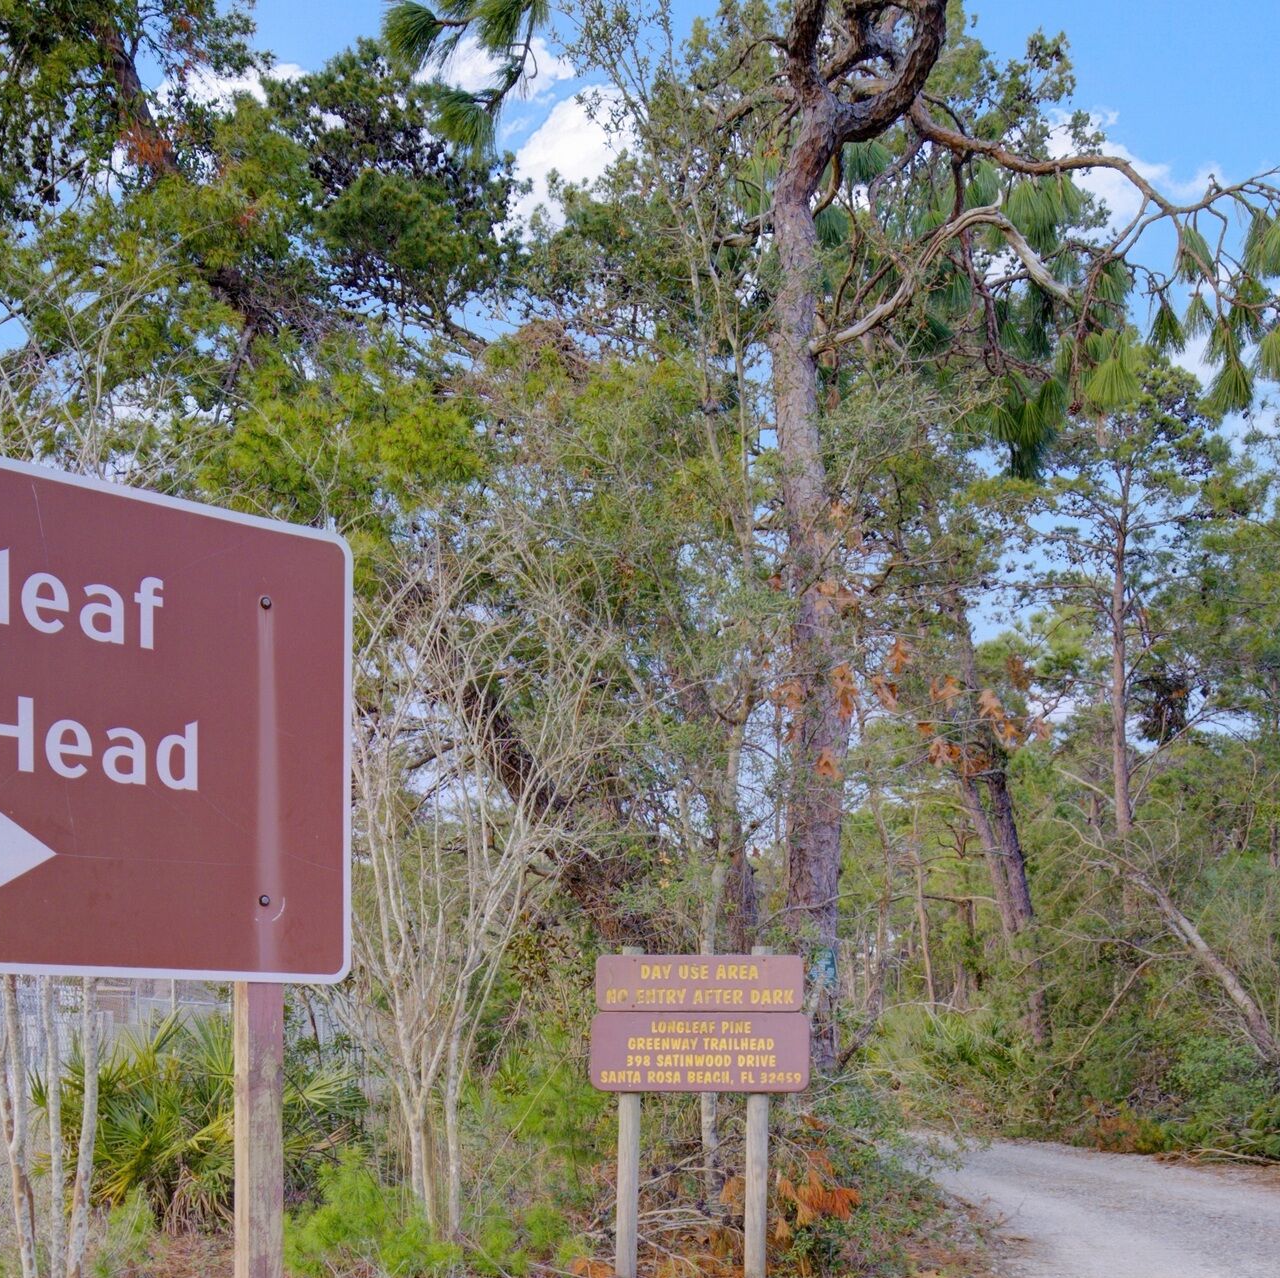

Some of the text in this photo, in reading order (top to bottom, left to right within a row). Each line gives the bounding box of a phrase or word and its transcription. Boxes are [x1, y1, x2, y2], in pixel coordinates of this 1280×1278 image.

[641, 965, 758, 980] DAY USE AREA
[607, 989, 794, 1004] NO ENTRY AFTER DARK
[652, 1021, 752, 1034] LONGLEAF PINE
[628, 1038, 774, 1050] GREENWAY TRAILHEAD
[626, 1055, 776, 1067] 398 SATINWOOD DRIVE
[600, 1071, 802, 1085] SANTA ROSA BEACH, FL 32459
